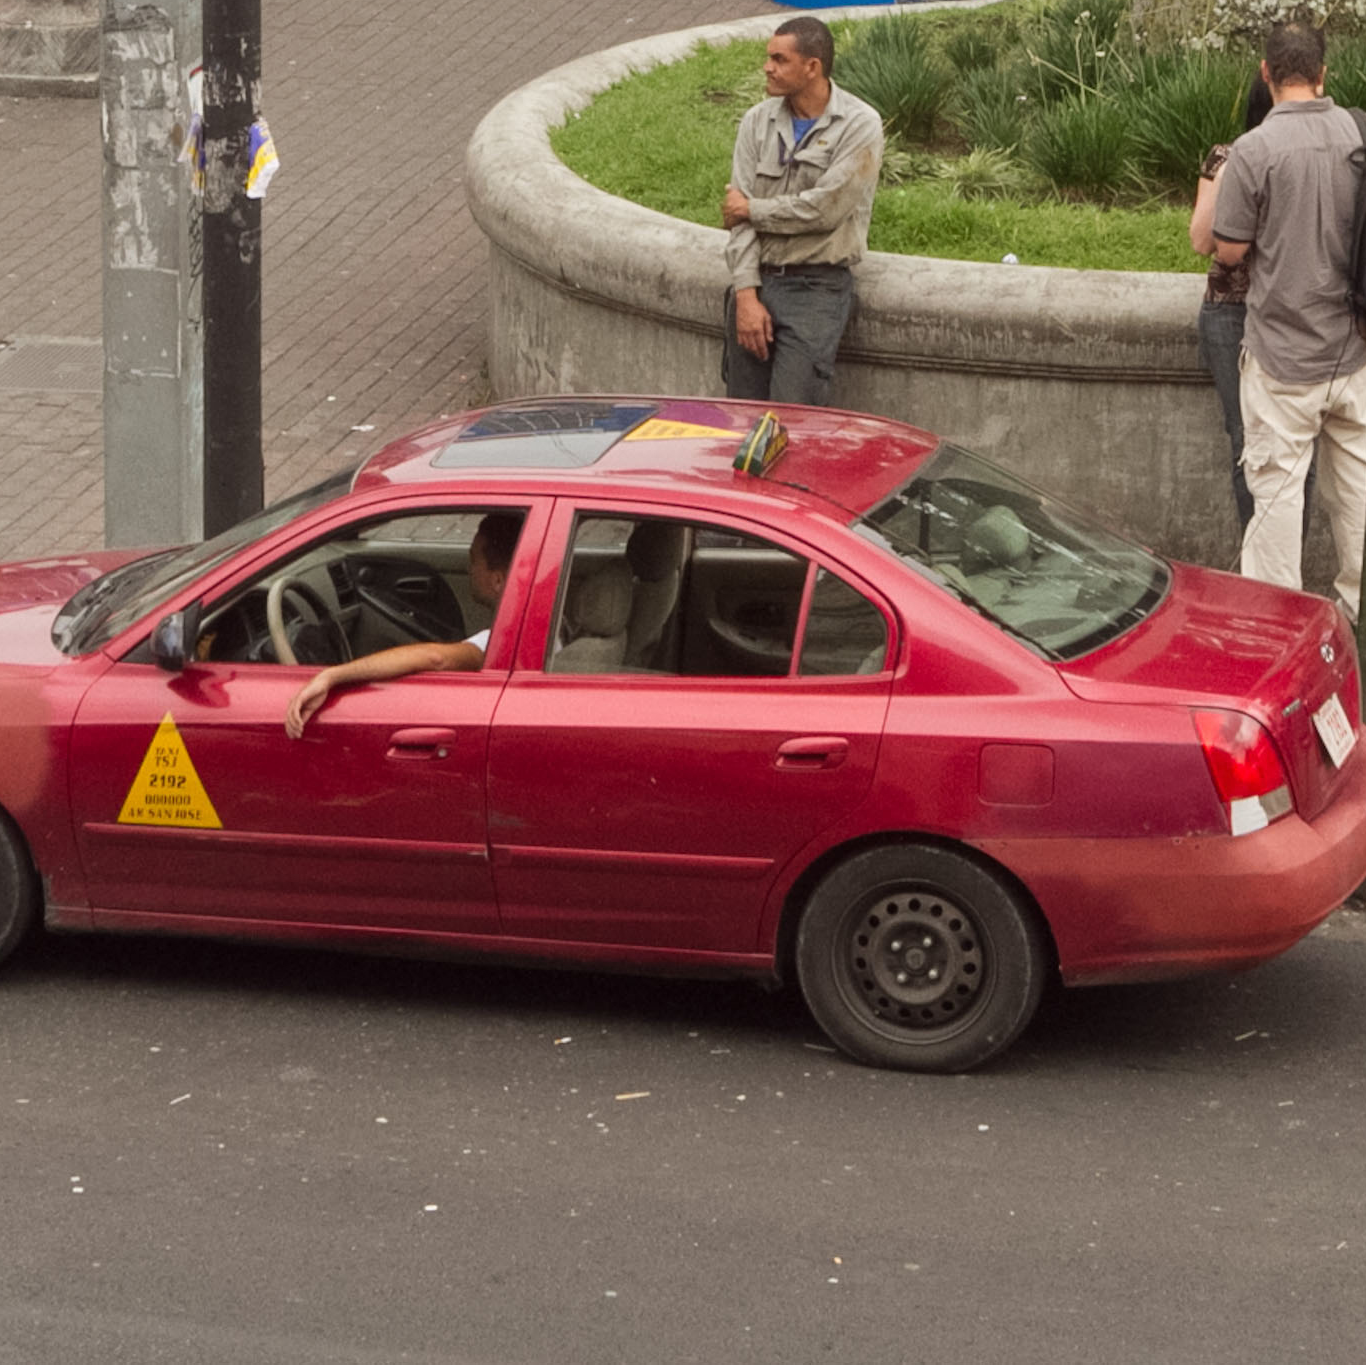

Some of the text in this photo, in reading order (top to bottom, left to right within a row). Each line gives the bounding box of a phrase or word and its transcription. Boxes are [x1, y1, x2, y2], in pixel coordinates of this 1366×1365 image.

[155, 747, 180, 755] TAXI
[155, 755, 178, 768] TSJ
[149, 773, 187, 789] 2192
[148, 808, 172, 819] SAN
[175, 808, 202, 821] JOSE
